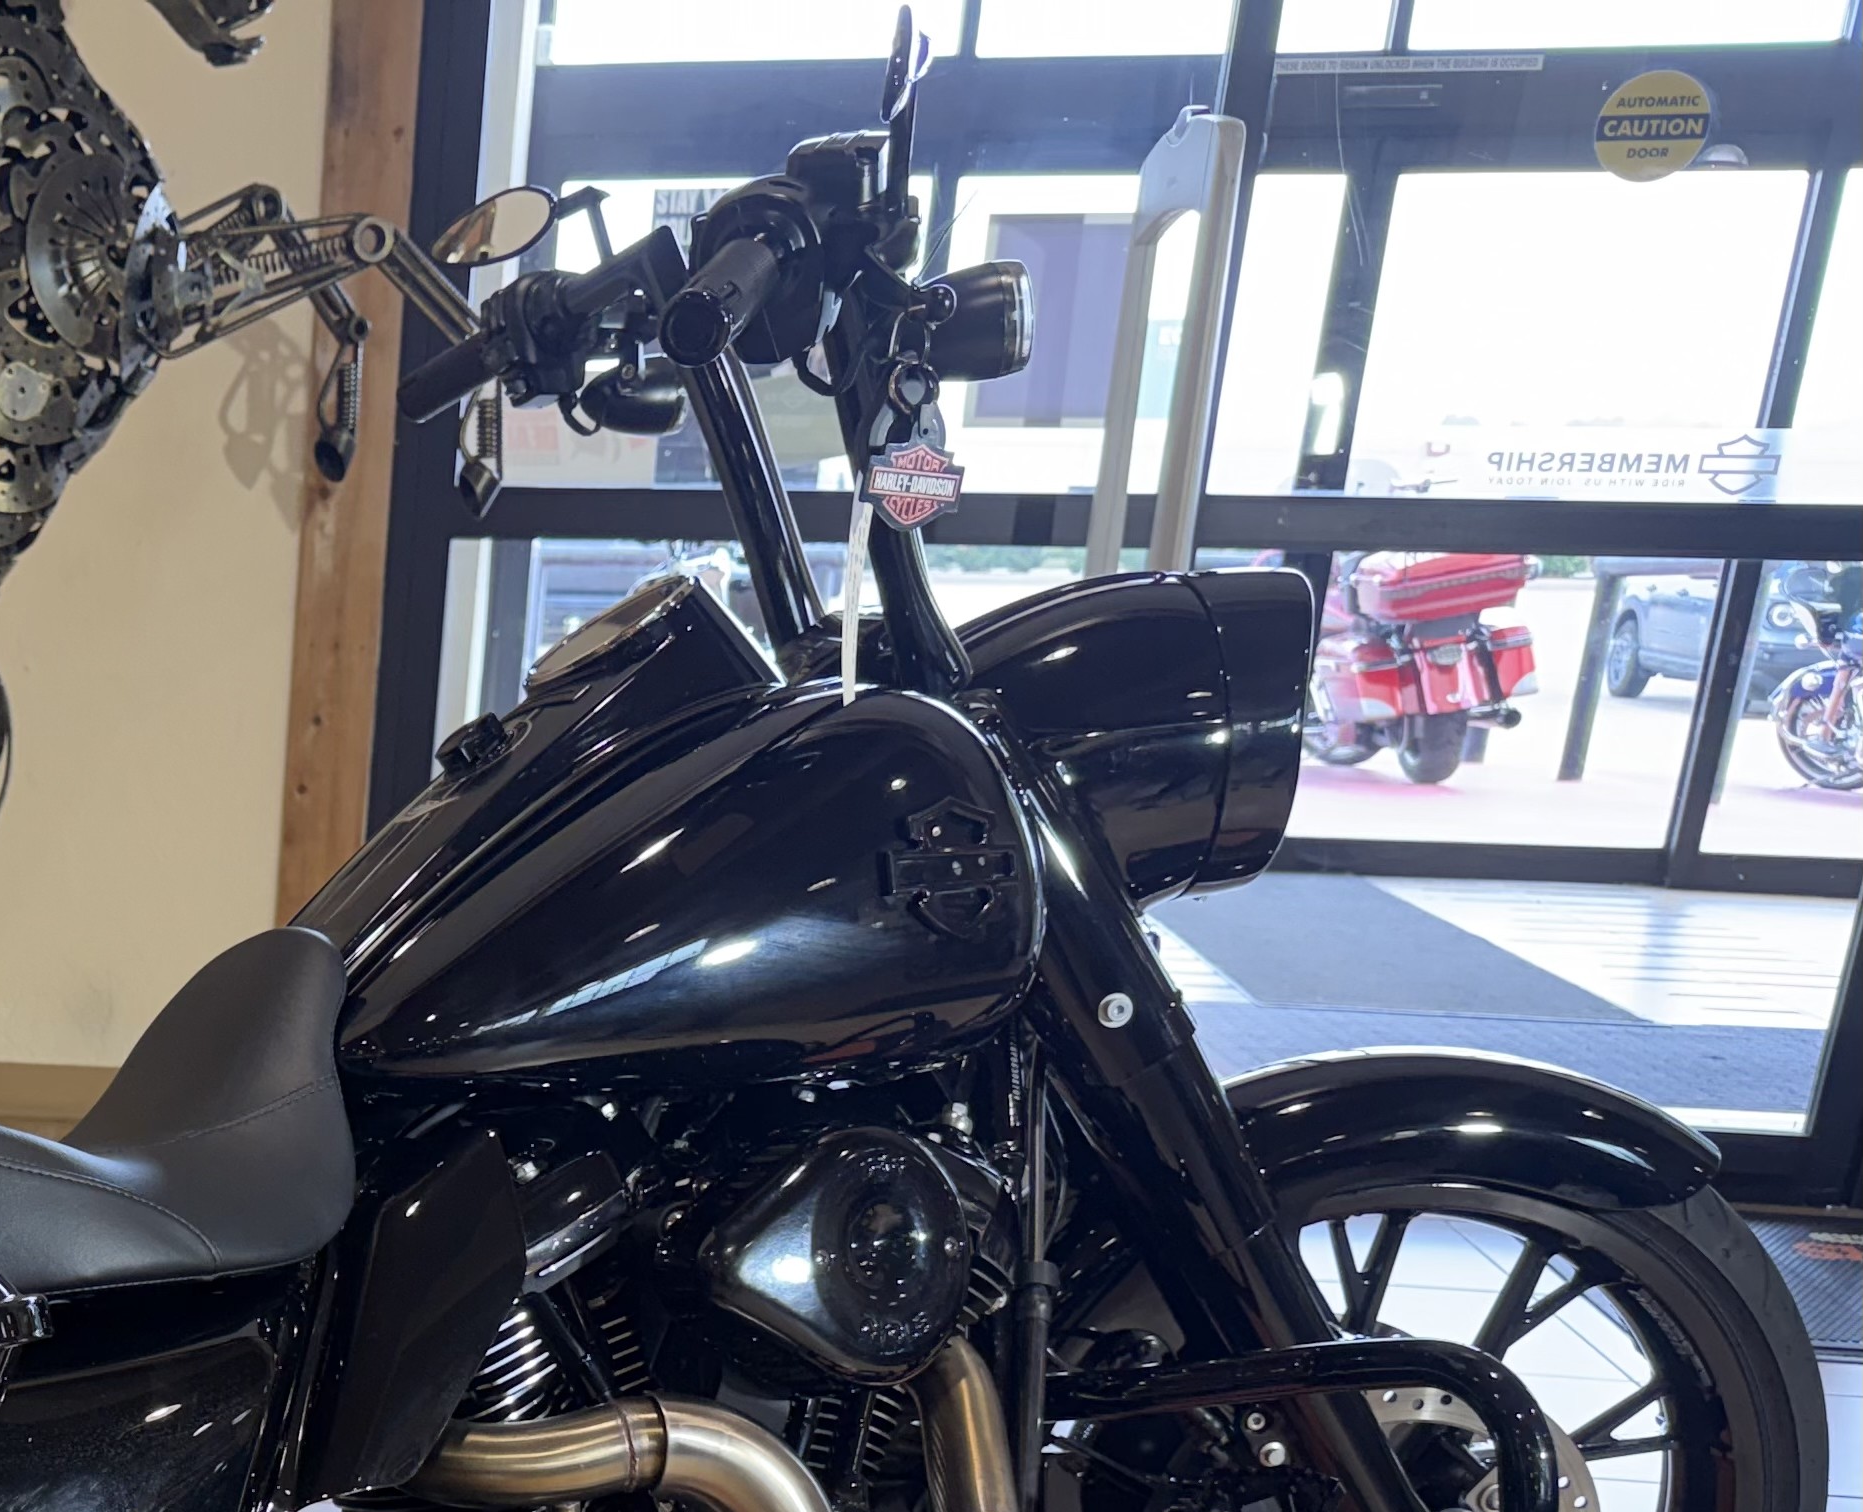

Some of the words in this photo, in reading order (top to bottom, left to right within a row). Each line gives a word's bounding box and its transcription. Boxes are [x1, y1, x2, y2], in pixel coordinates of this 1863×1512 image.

[1616, 95, 1700, 109] AUTOMATIC
[1603, 118, 1705, 137] CAUTION
[1626, 147, 1669, 159] DOOR
[655, 189, 699, 214] STAY
[897, 450, 940, 472] MOTOR
[873, 472, 956, 497] HARLEY-DAVIDSON
[888, 496, 933, 519] CYCLES
